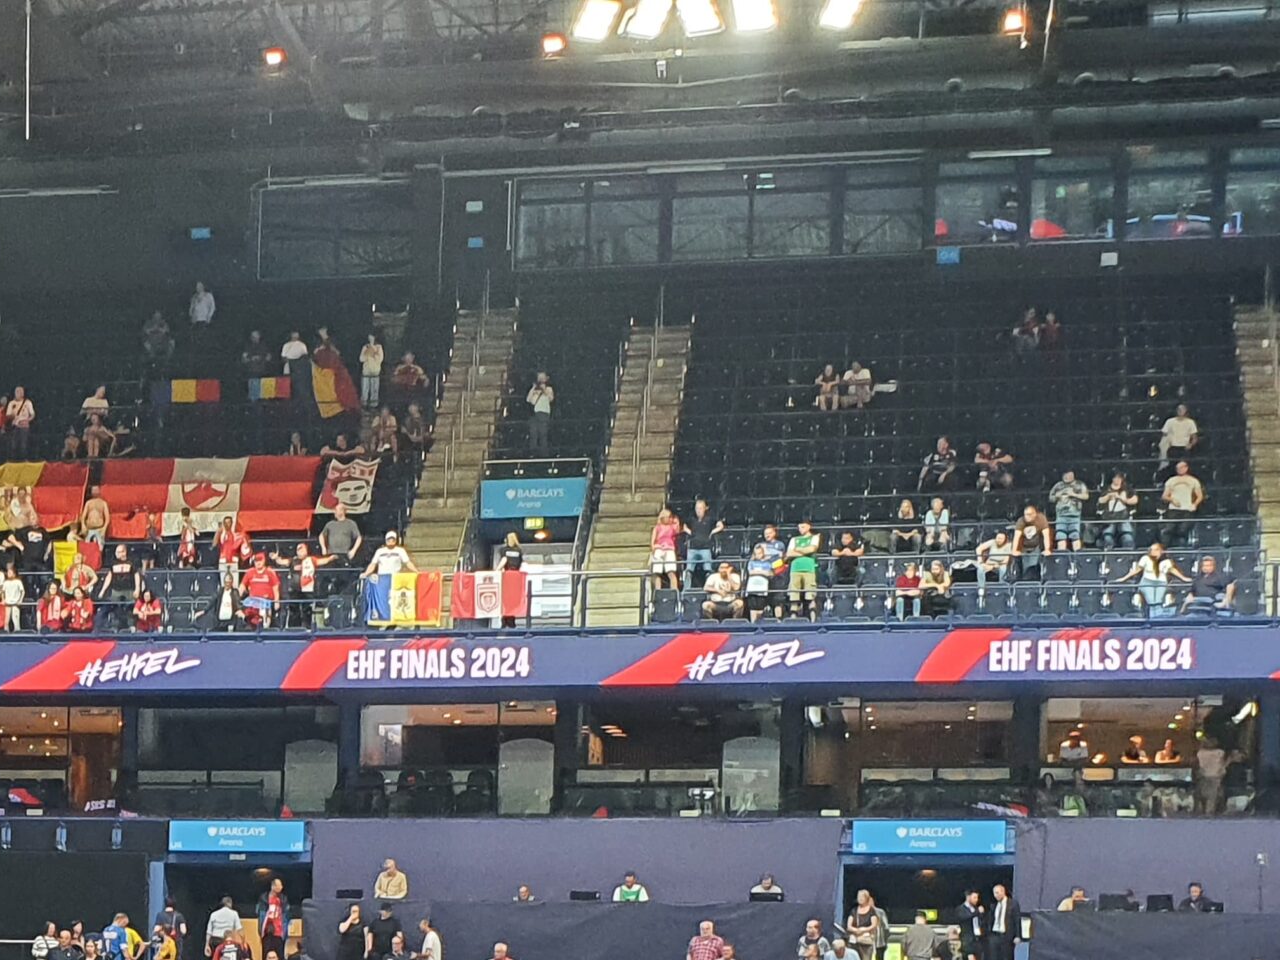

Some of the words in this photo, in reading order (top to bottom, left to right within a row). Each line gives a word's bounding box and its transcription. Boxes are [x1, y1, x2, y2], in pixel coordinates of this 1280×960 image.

[517, 488, 564, 498] BARCLAYS
[76, 648, 201, 687] #EHFEL
[347, 649, 387, 680] EHF
[390, 648, 465, 680] FINALS
[470, 647, 530, 679] 2024
[683, 639, 825, 680] #EHFEL
[989, 639, 1032, 671] EHF
[1037, 639, 1121, 671] FINALS
[1126, 638, 1193, 671] 2024
[219, 826, 266, 837] BARCLAYS
[909, 827, 962, 837] BARCLAYS
